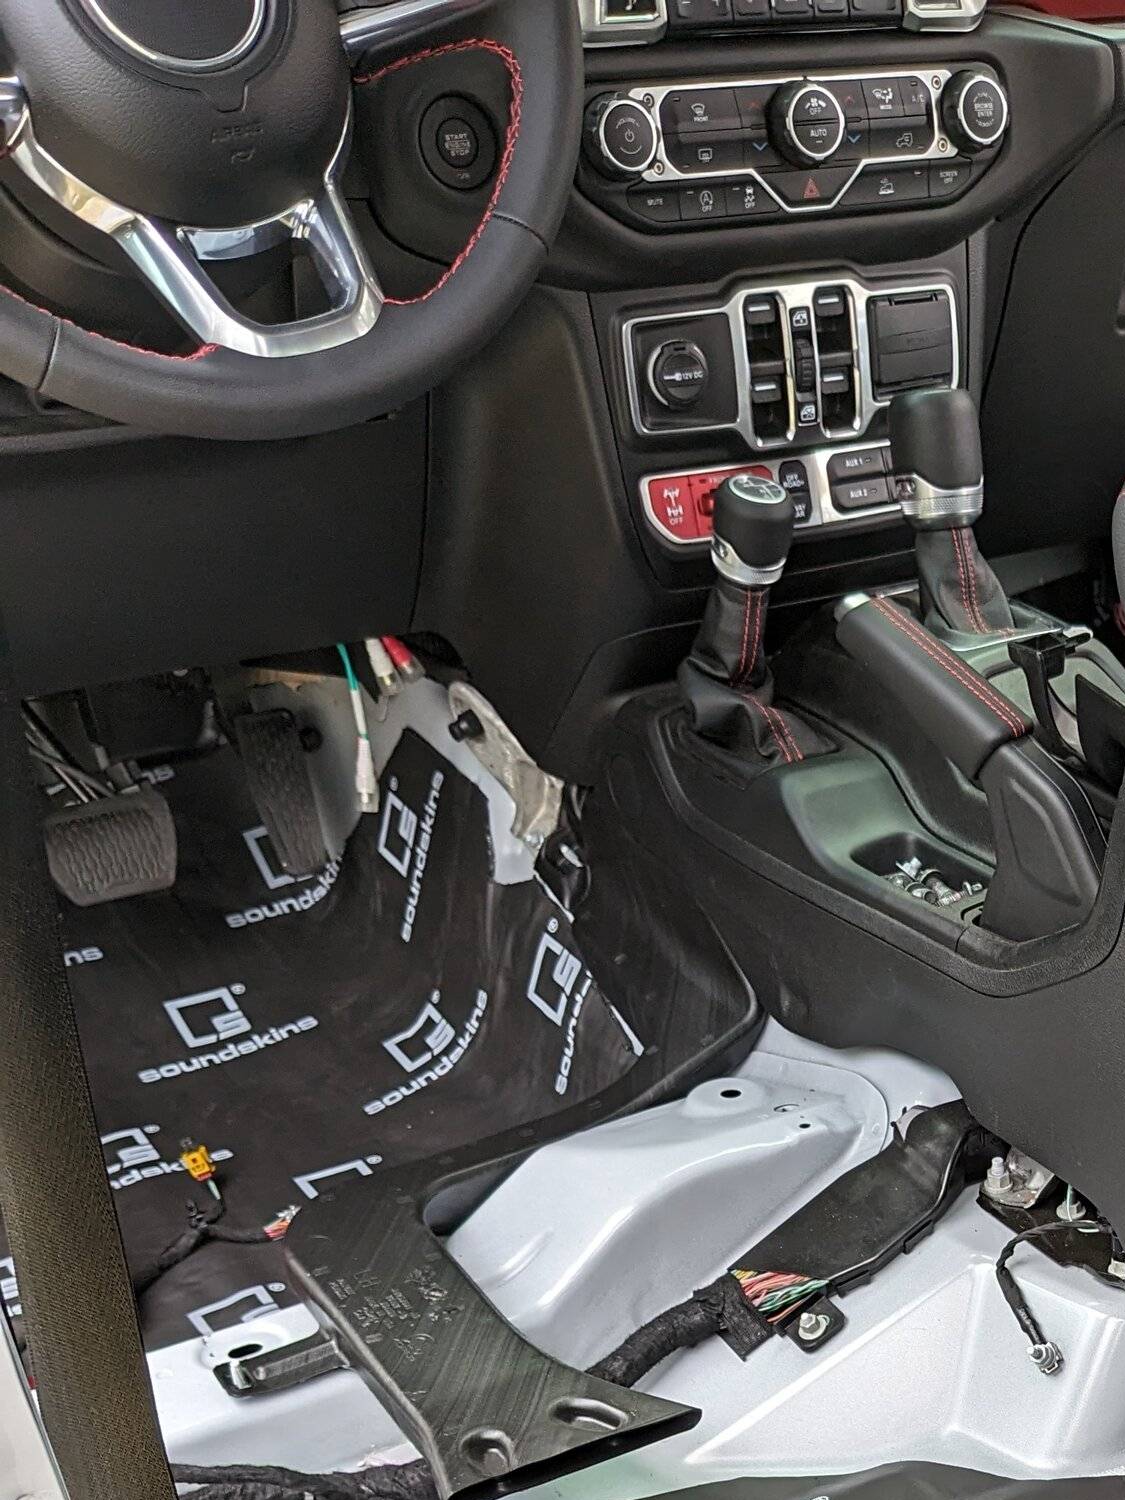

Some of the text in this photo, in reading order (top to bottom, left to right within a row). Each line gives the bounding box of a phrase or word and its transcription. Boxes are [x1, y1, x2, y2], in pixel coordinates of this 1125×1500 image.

[809, 127, 827, 137] AUTO
[845, 459, 858, 468] AUX
[850, 489, 862, 498] AUX
[402, 771, 443, 942] soundskins
[138, 1015, 318, 1084] soundskins
[363, 989, 487, 1115] soundskins
